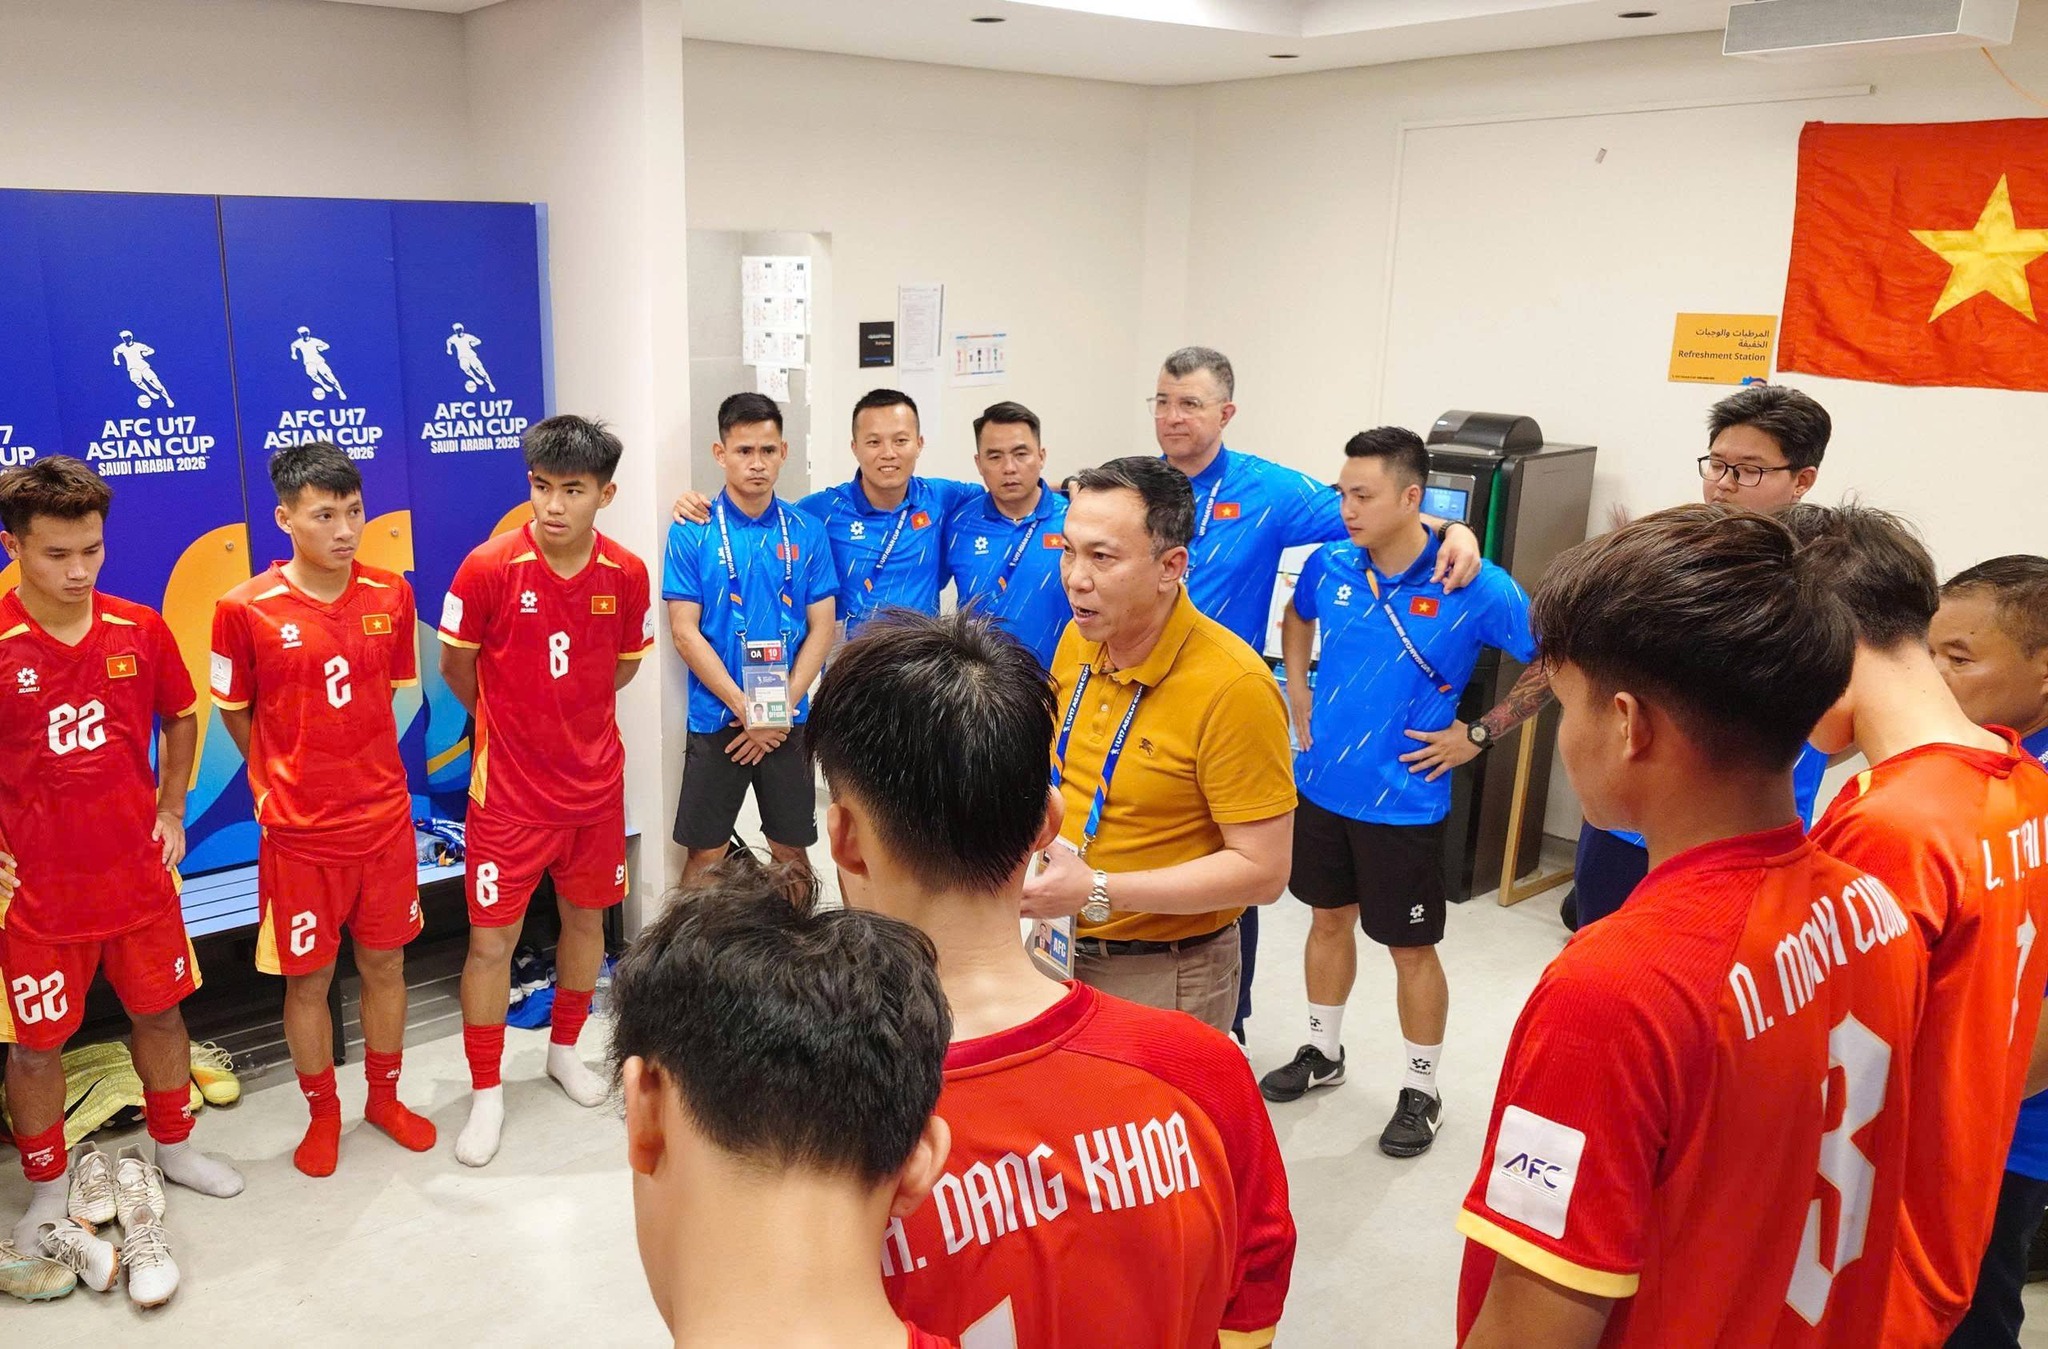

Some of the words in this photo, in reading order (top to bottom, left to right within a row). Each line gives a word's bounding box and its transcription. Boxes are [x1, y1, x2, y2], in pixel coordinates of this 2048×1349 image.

[1678, 350, 1732, 359] Refreshment
[1734, 352, 1766, 361] Station
[278, 410, 325, 429] AFC
[330, 408, 366, 427] U17
[434, 402, 478, 420] AFC
[480, 400, 513, 419] U17
[101, 418, 152, 439] AFC
[156, 416, 196, 436] U17
[336, 427, 383, 446] CUP
[421, 421, 484, 440] ASIAN
[486, 417, 528, 437] CUP
[0, 446, 36, 466] UP
[86, 438, 161, 461] ASIAN
[165, 435, 215, 457] CUP
[346, 446, 375, 460] 2026
[430, 440, 458, 454] SAUDI
[460, 437, 494, 452] ARABIA
[495, 436, 520, 450] 2026
[98, 461, 131, 476] SAUDI
[134, 458, 175, 474] ARABIA
[177, 456, 206, 472] 2026
[549, 630, 570, 680] 8
[750, 650, 762, 659] OA
[768, 648, 778, 657] 10
[324, 655, 351, 709] 2
[48, 699, 107, 755] 22
[476, 861, 499, 908] 8
[290, 910, 317, 957] 2
[1053, 937, 1066, 958] AFC
[11, 970, 69, 1025] 22
[1728, 961, 1775, 1041] N.
[1503, 1152, 1563, 1189] AFC
[1786, 1012, 1892, 1327] 3
[931, 1142, 1069, 1256] DANG
[1073, 1110, 1201, 1214] KHOA
